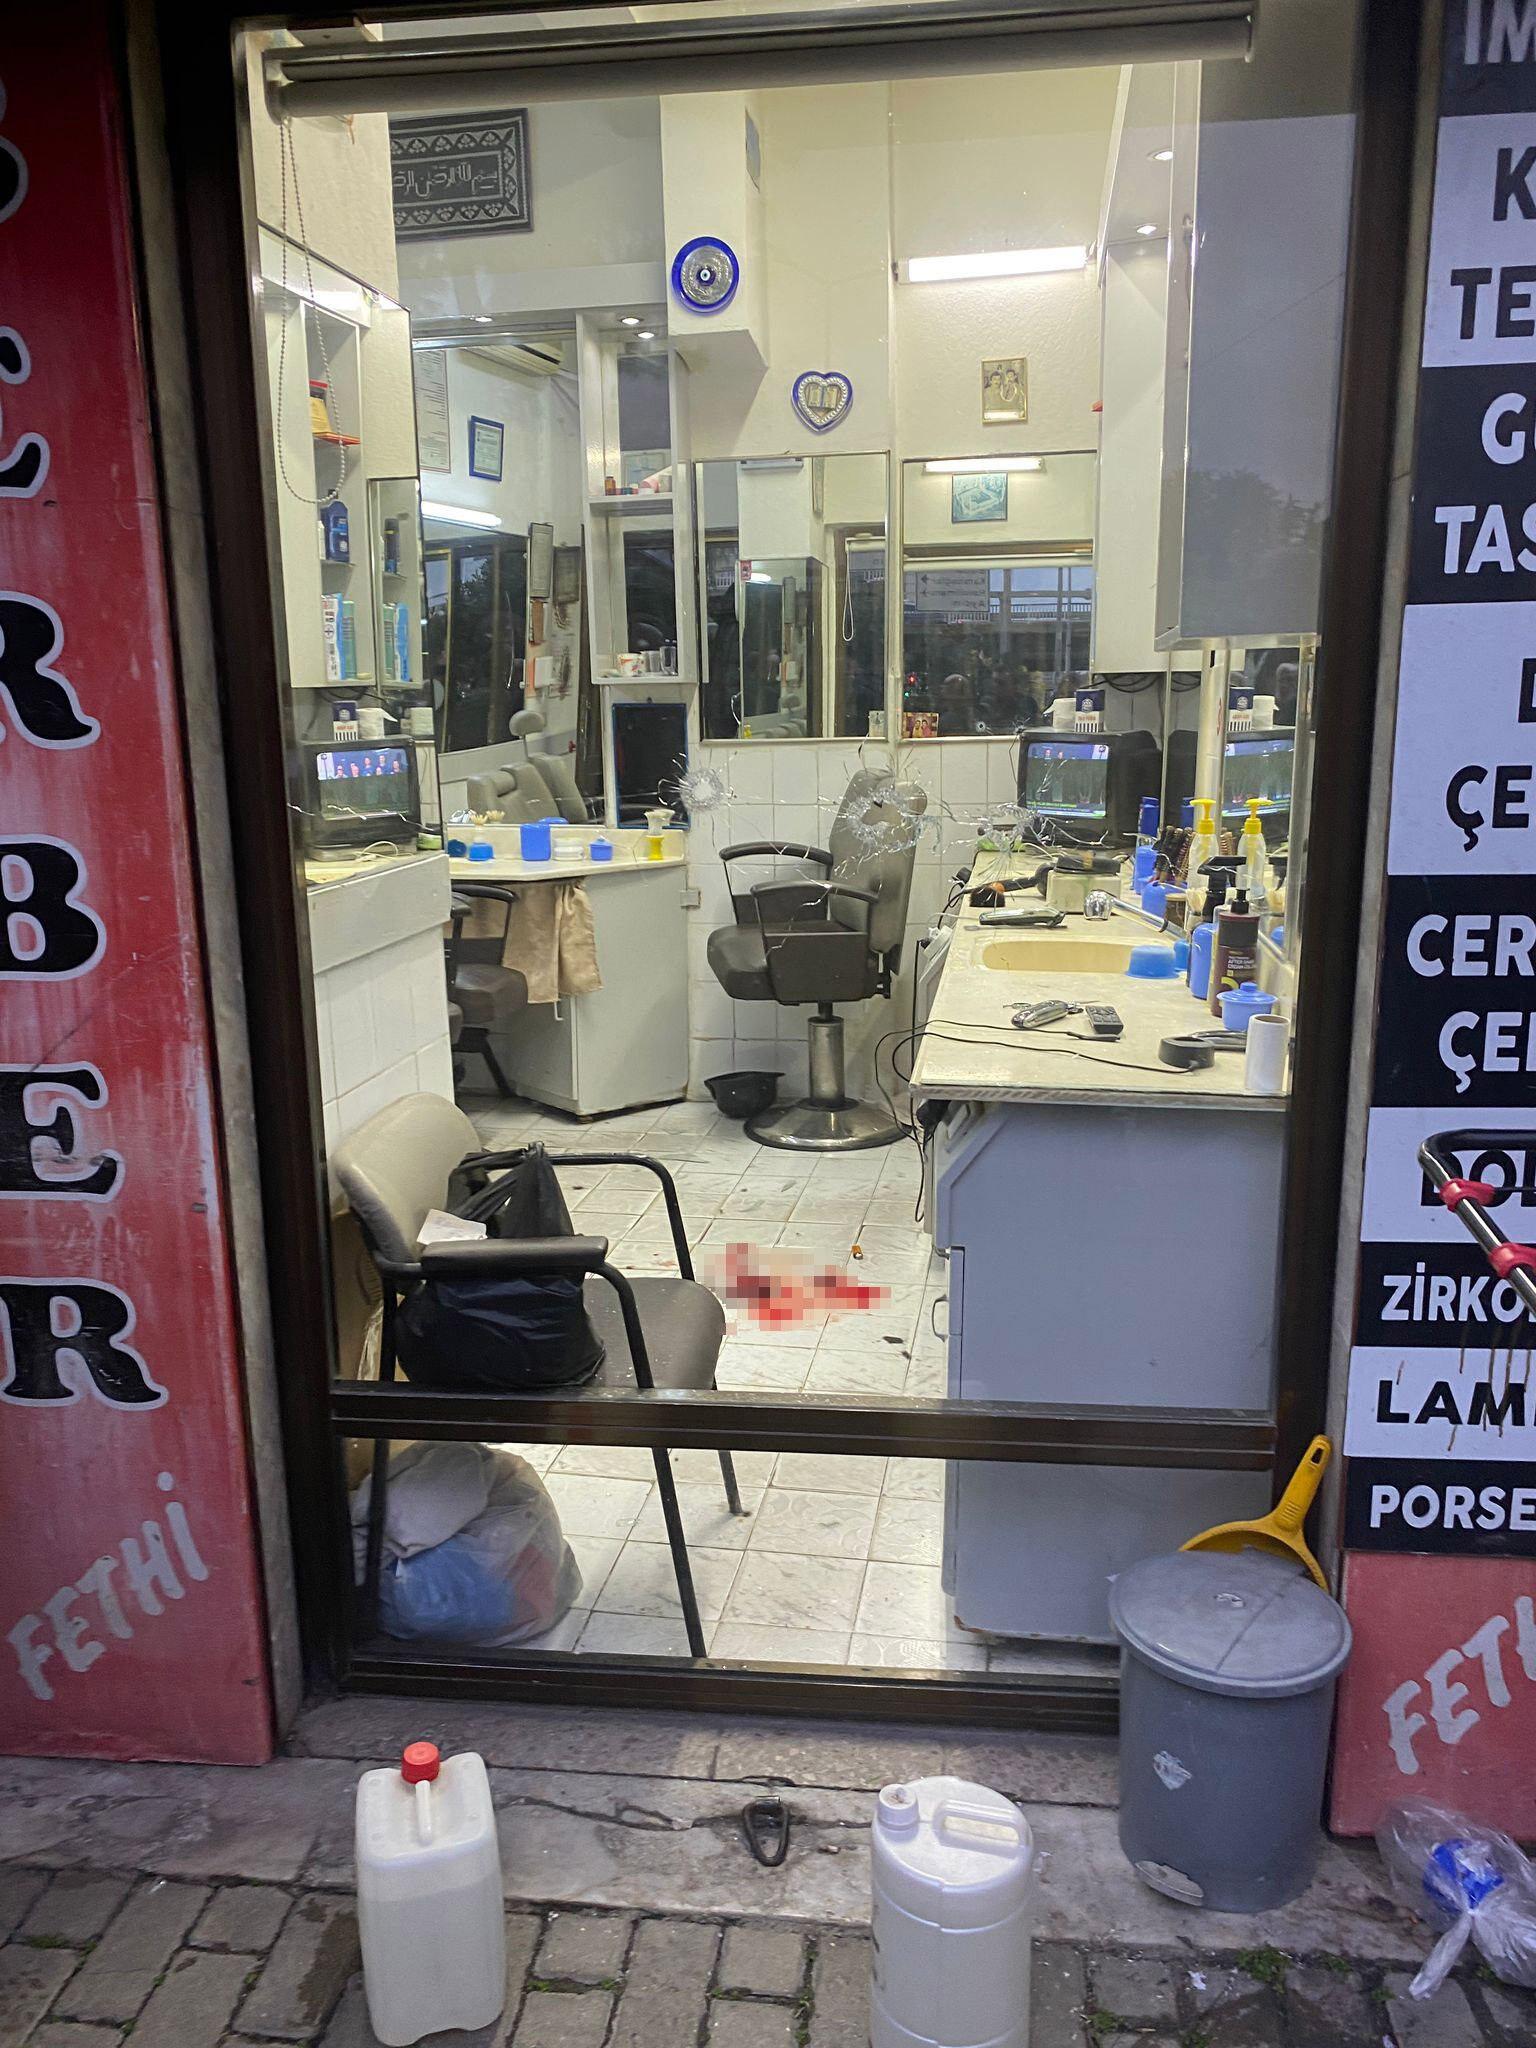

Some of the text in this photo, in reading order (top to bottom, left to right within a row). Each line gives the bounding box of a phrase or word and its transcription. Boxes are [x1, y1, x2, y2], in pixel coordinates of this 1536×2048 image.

[1450, 265, 1536, 340] TE
[1446, 765, 1532, 852] ÇE
[1407, 914, 1536, 977] CER
[1438, 1010, 1536, 1094] ÇE
[1380, 1262, 1536, 1322] ZİRKO
[1376, 1380, 1536, 1427] LAM
[1369, 1485, 1536, 1531] PORSE
